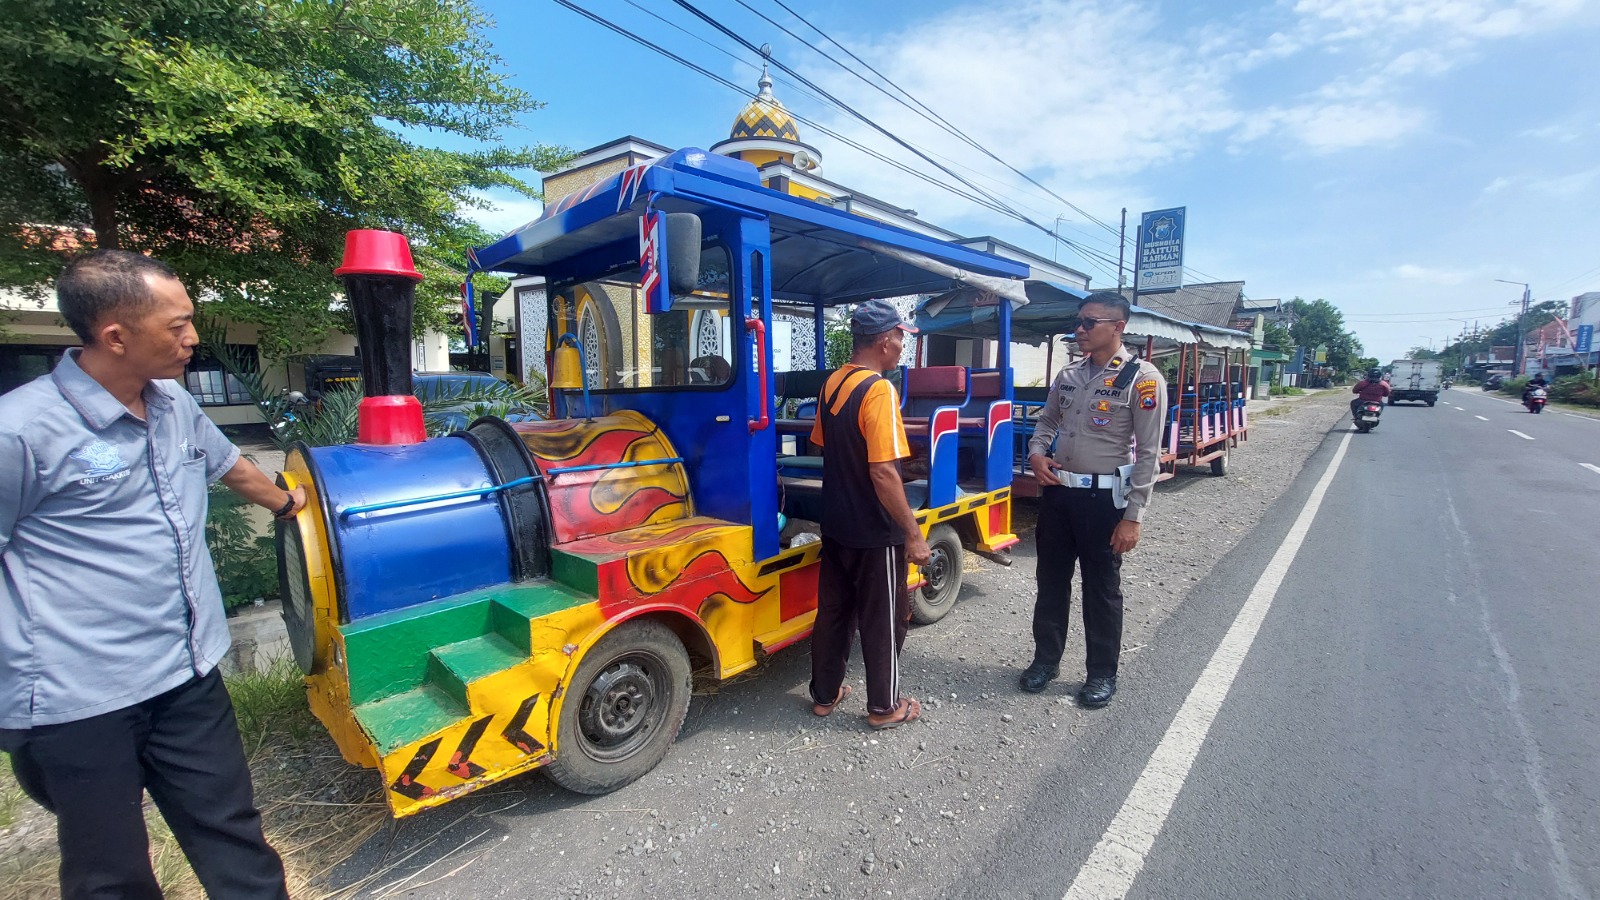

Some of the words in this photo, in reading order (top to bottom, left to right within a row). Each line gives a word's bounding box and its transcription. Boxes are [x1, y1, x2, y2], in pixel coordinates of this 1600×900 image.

[1143, 245, 1179, 256] BAITUR
[1142, 253, 1179, 263] RAHMAN
[1094, 388, 1121, 398] POLRI
[80, 476, 99, 485] UNIT
